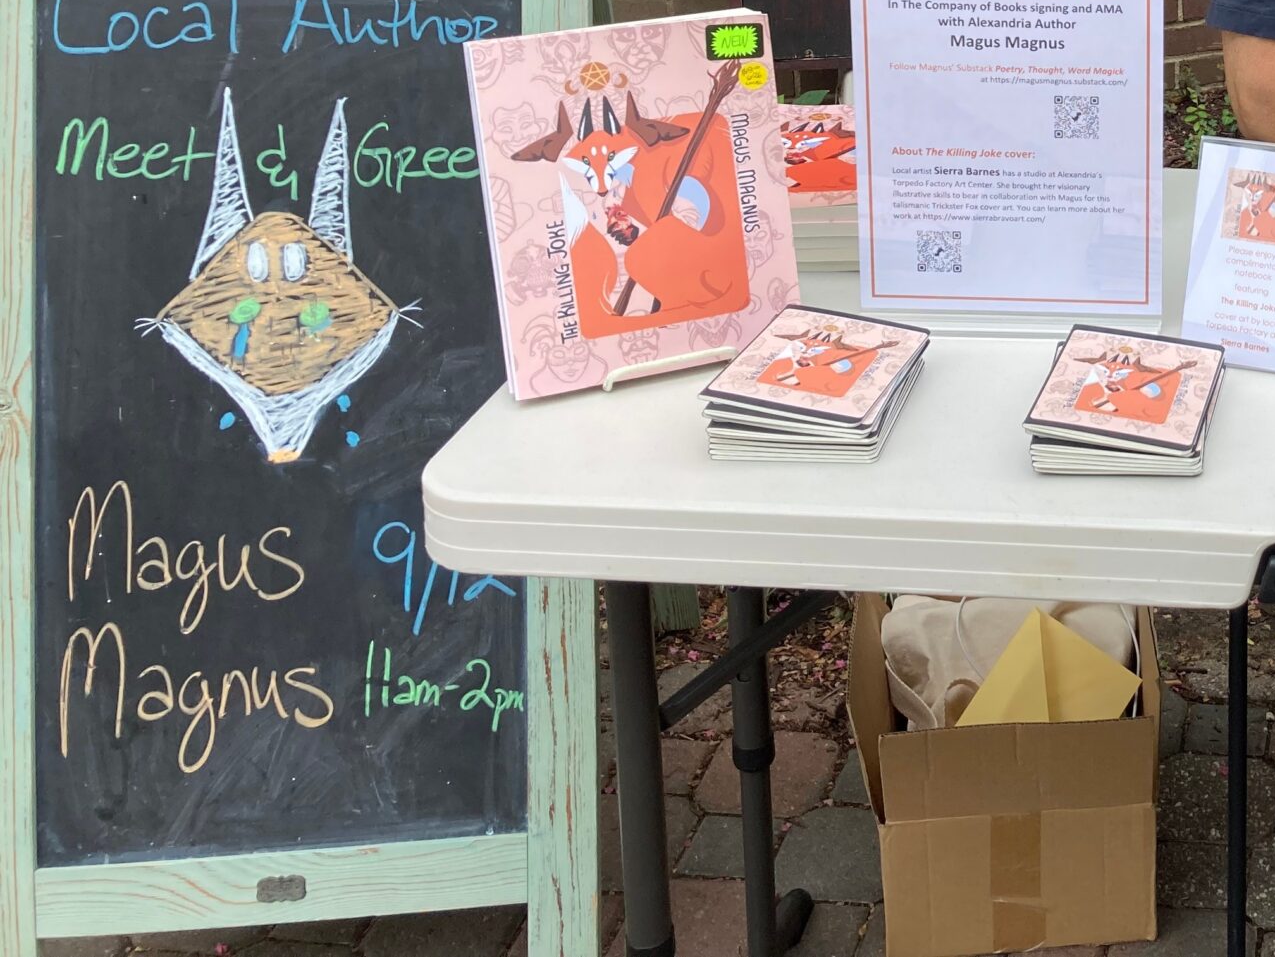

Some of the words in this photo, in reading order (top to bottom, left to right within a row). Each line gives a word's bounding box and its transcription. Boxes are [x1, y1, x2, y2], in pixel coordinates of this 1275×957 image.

[888, 0, 898, 8] In
[901, 0, 922, 10] The
[924, 0, 977, 12] Company
[980, 2, 991, 11] of
[994, 2, 1028, 12] Books
[1030, 3, 1069, 14] signing
[1072, 4, 1092, 13] and
[1095, 4, 1124, 14] AMA
[938, 16, 964, 26] with
[968, 16, 1032, 28] Alexandria
[1034, 18, 1076, 29] Author
[721, 31, 748, 49] NEW
[950, 34, 1000, 50] Magus
[1005, 36, 1066, 52] Magnus
[956, 64, 992, 72] Substack
[996, 66, 1026, 74] Poetry,
[1028, 66, 1065, 75] Thought,
[1093, 68, 1124, 76] Magick
[730, 113, 751, 165] MAGUS
[55, 117, 218, 181] Meet
[257, 124, 299, 200] &
[353, 121, 480, 194] Gree
[892, 147, 923, 156] About
[926, 148, 944, 156] The
[946, 148, 978, 160] Killing
[979, 149, 1002, 158] Joke
[1004, 151, 1036, 159] cover:
[934, 166, 963, 176] Sierra
[966, 168, 1000, 176] Barnes
[1024, 170, 1046, 178] studio
[892, 179, 924, 187] Torpedo
[925, 180, 952, 188] Factory
[954, 180, 966, 188] Art
[1012, 182, 1042, 190] brought
[1057, 183, 1090, 192] visionary
[737, 169, 760, 234] MAGNUS
[962, 192, 979, 200] bear
[980, 192, 988, 200] in
[989, 192, 1038, 200] collaboration
[1058, 194, 1082, 202] Magus
[1084, 194, 1095, 202] for
[547, 218, 566, 260] JOKE
[1229, 245, 1253, 255] Please
[1255, 250, 1275, 260] enjoy
[554, 262, 575, 316] KILLING
[1235, 284, 1269, 296] featuring
[1221, 296, 1234, 305] The
[1236, 299, 1258, 310] Killing
[561, 310, 580, 344] THE
[1221, 338, 1242, 347] Sierra
[1244, 342, 1270, 352] Barnes
[68, 480, 305, 635] Magus
[60, 621, 334, 774] Magnus
